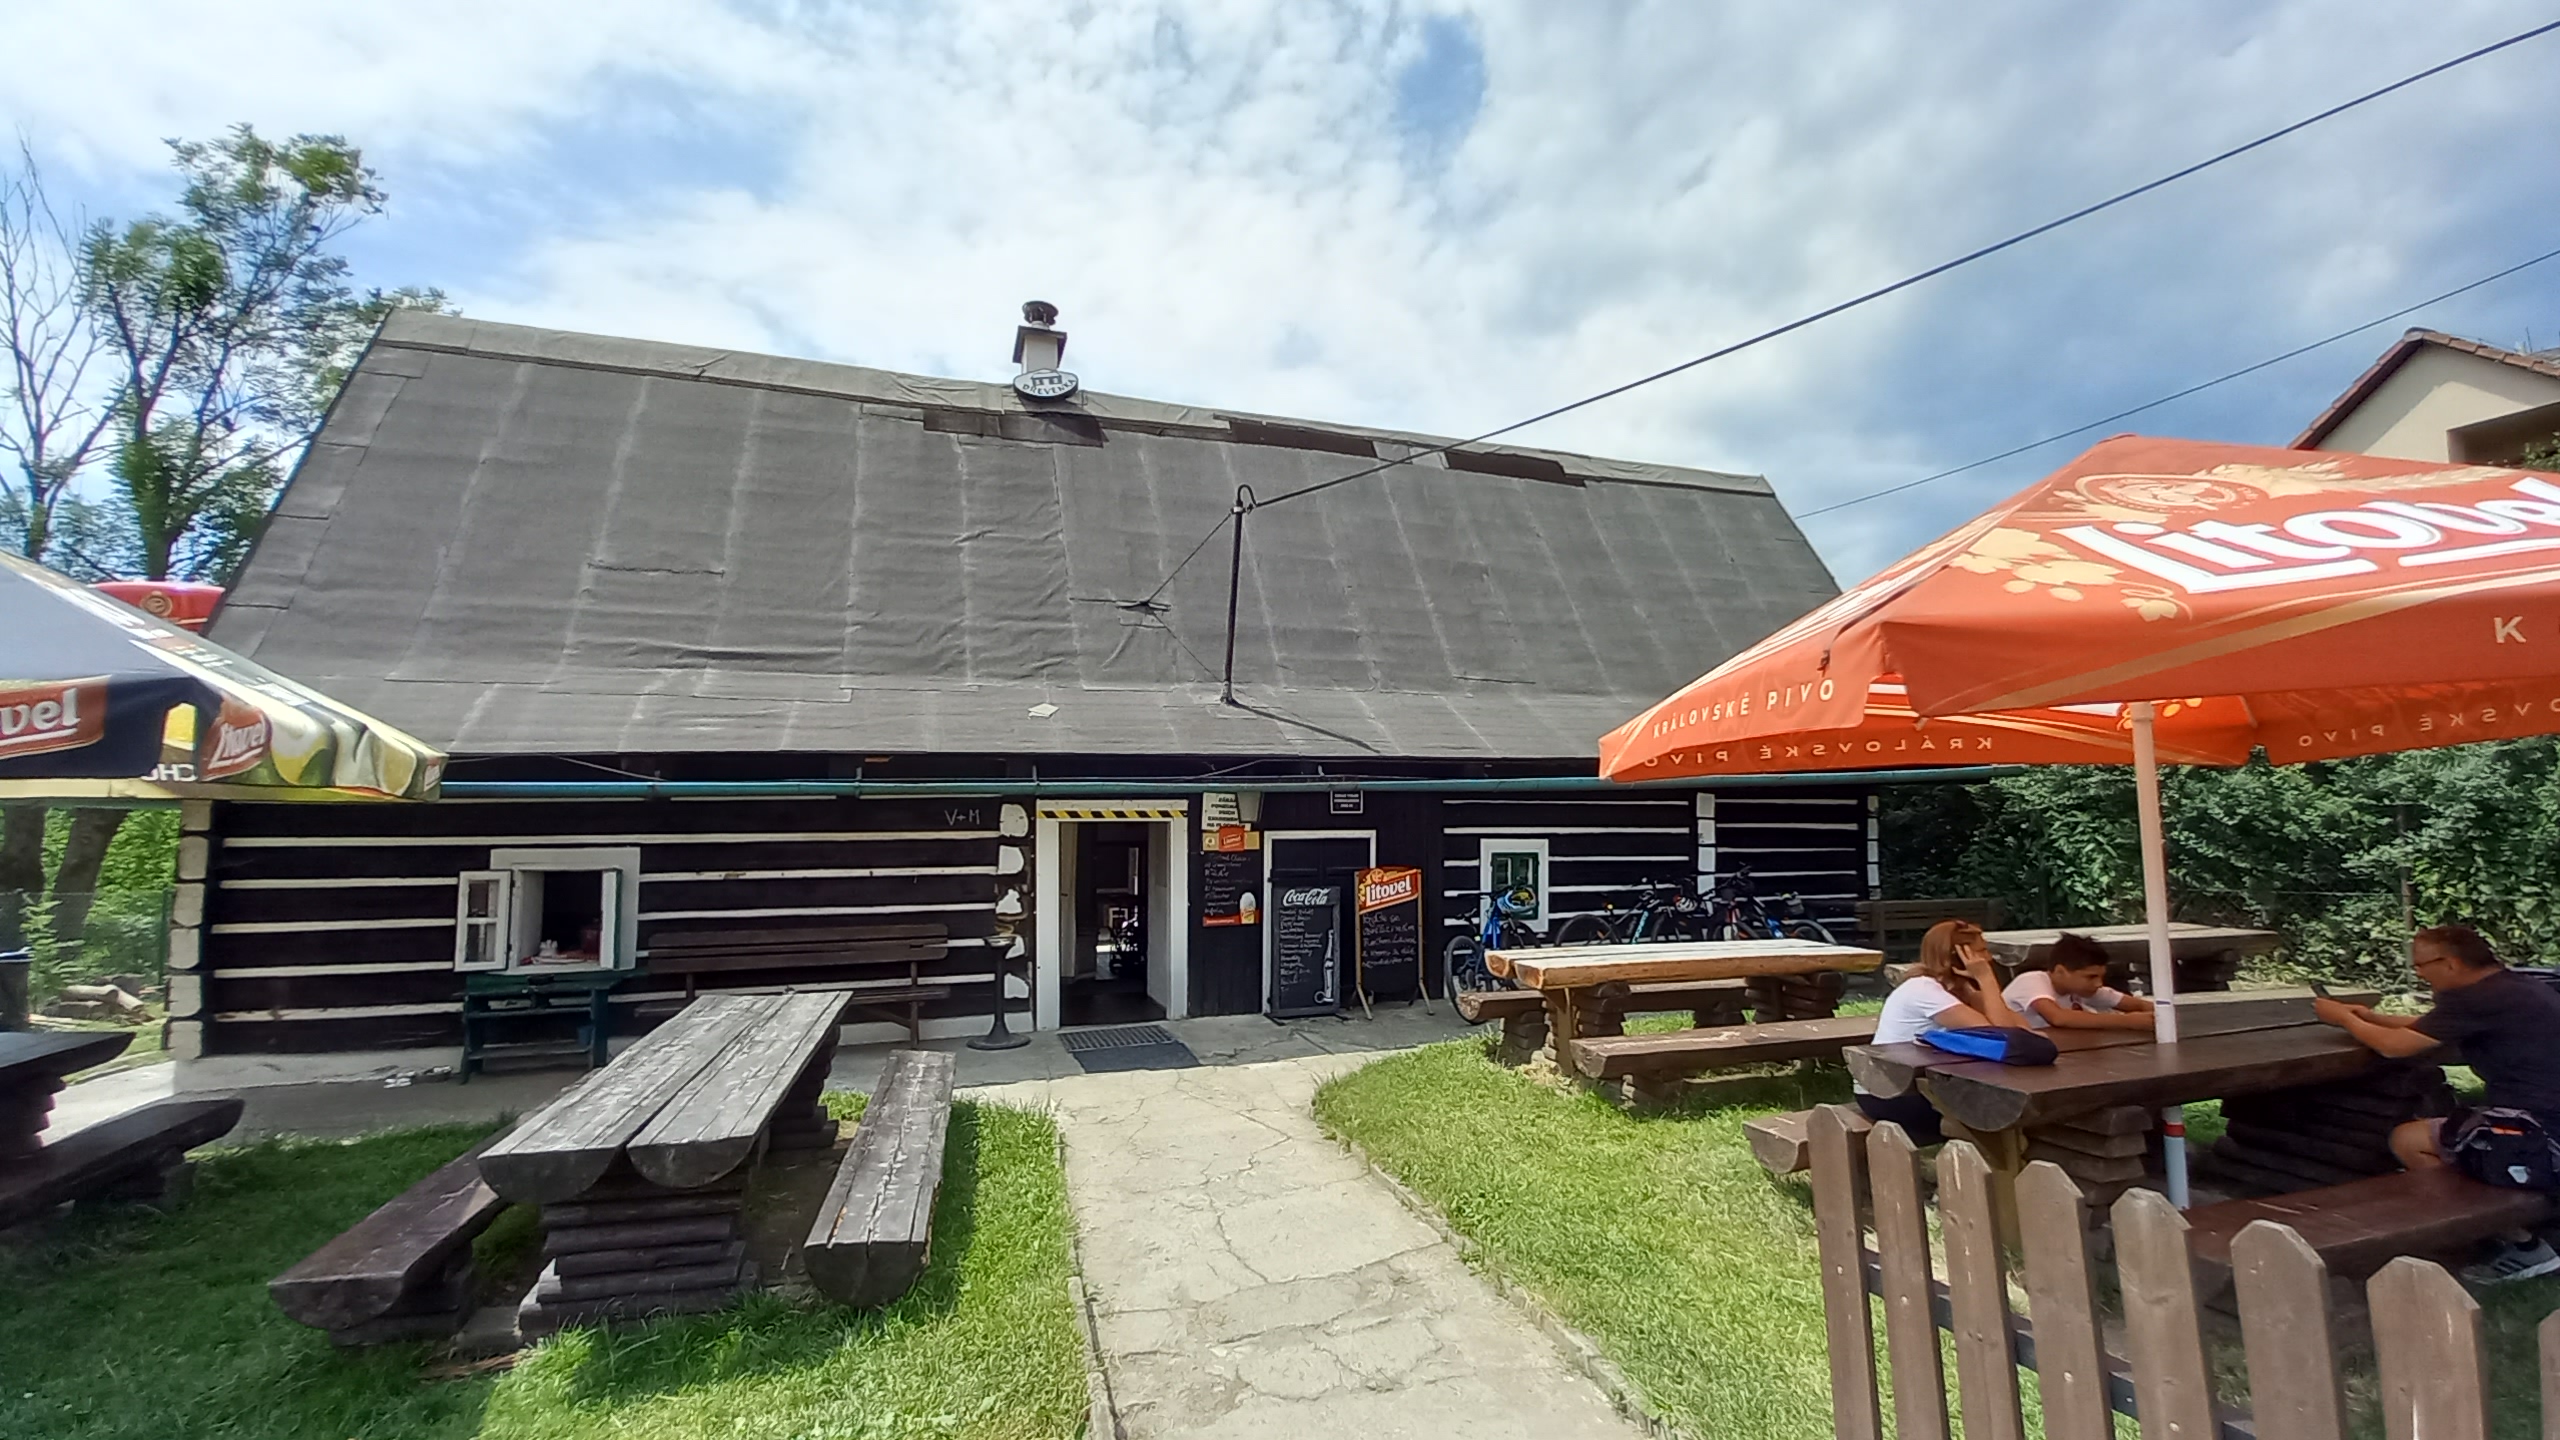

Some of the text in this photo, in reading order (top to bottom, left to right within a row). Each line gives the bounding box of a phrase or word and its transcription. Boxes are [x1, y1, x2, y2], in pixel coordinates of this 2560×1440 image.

[1653, 679, 1834, 739] KRÁLOVSKÉ PIVO
[1366, 875, 1412, 907] Litovel
